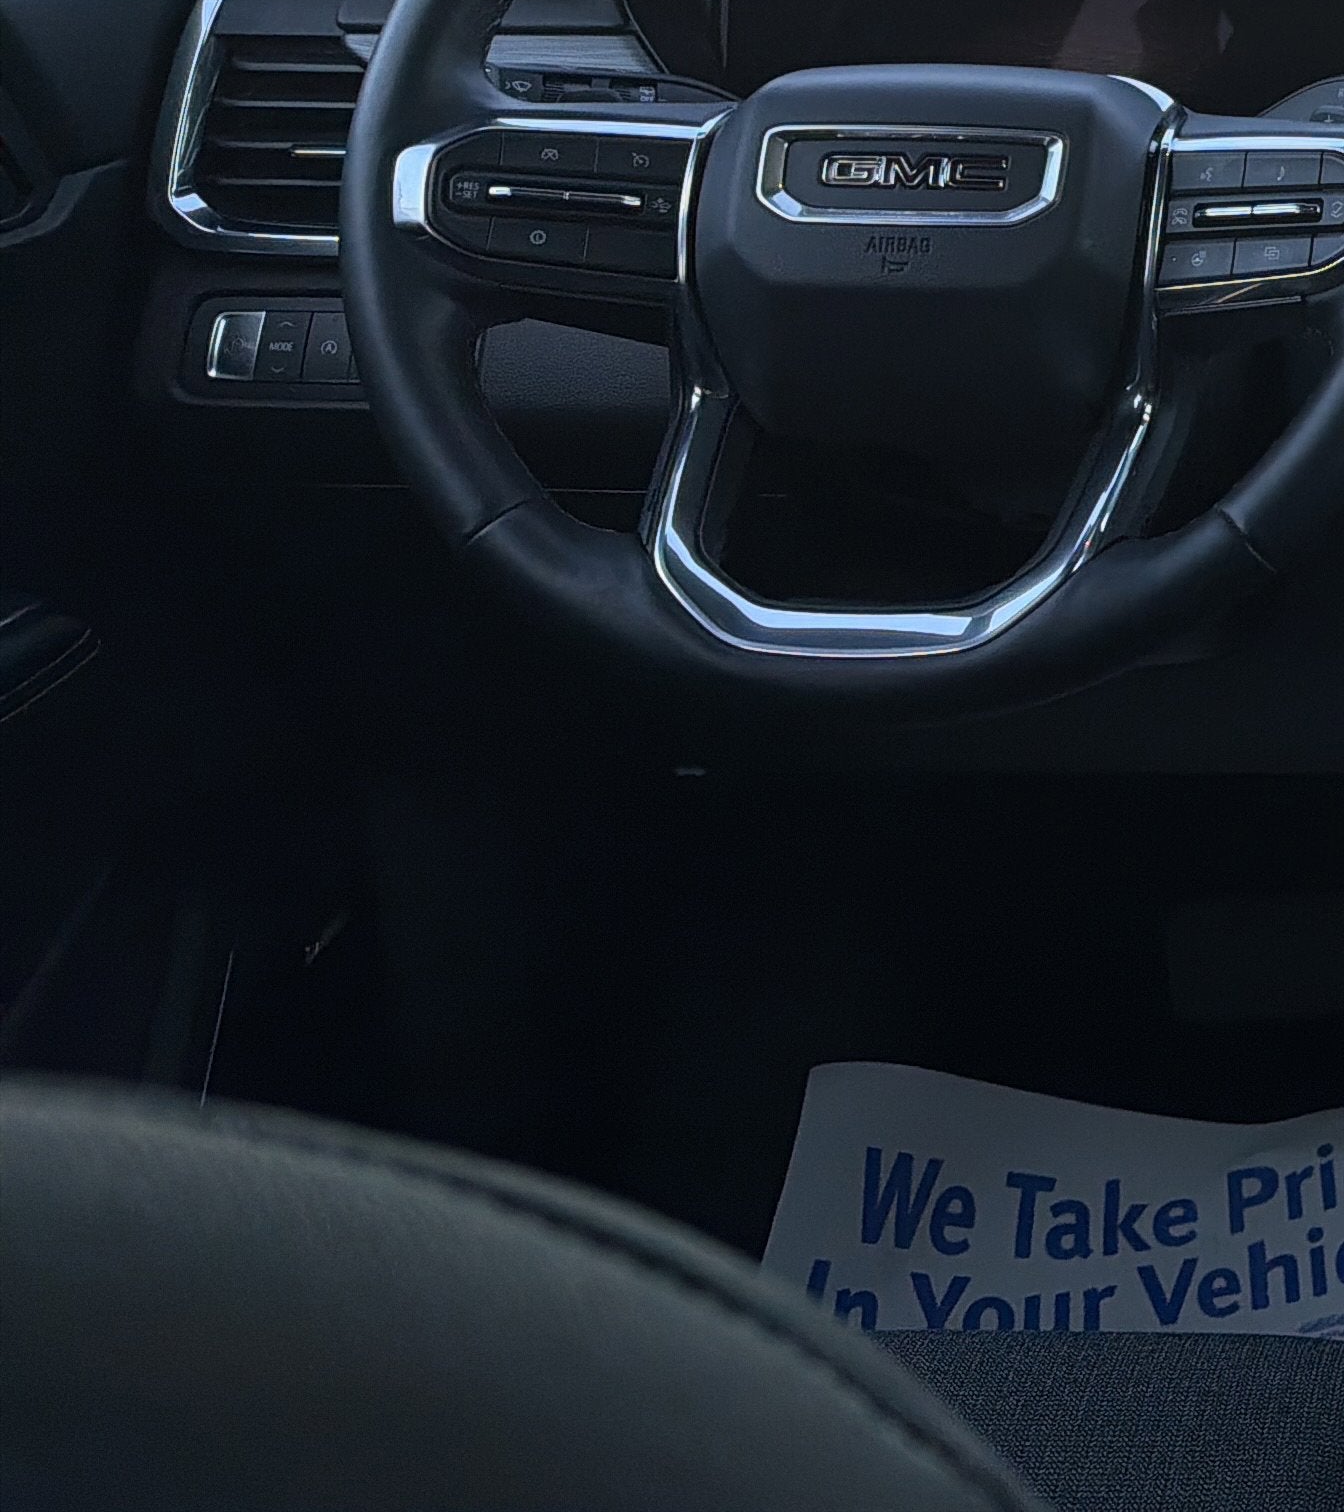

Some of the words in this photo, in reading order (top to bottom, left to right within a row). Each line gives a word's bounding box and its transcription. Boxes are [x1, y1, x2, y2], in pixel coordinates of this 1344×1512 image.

[821, 152, 1011, 191] GMC
[864, 235, 931, 254] AIRBAG
[269, 341, 295, 352] MODE
[861, 1146, 977, 1256] We
[1006, 1172, 1199, 1262] Take
[806, 1259, 879, 1331] In
[910, 1272, 1119, 1331] Your
